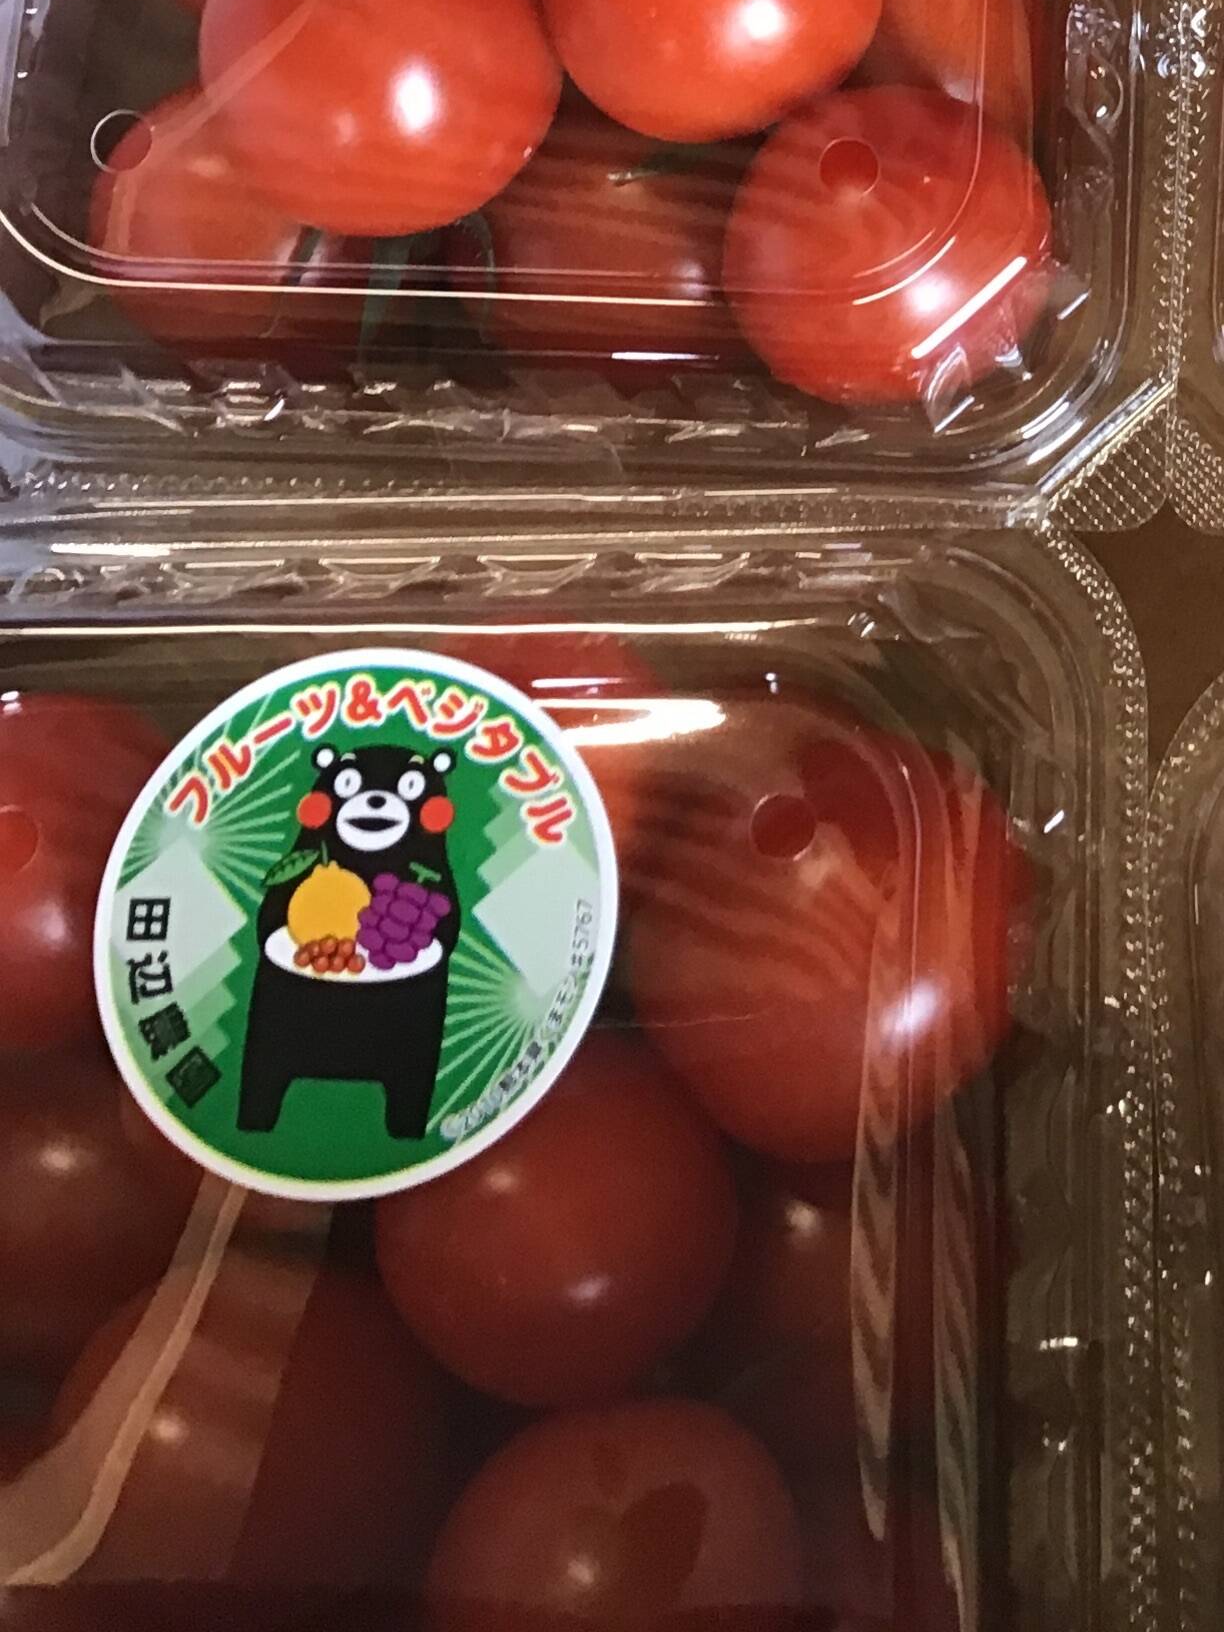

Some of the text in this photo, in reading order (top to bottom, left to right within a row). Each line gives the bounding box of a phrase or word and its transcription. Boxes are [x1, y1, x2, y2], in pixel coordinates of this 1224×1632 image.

[168, 679, 573, 843] フルーツ&ベジタブル
